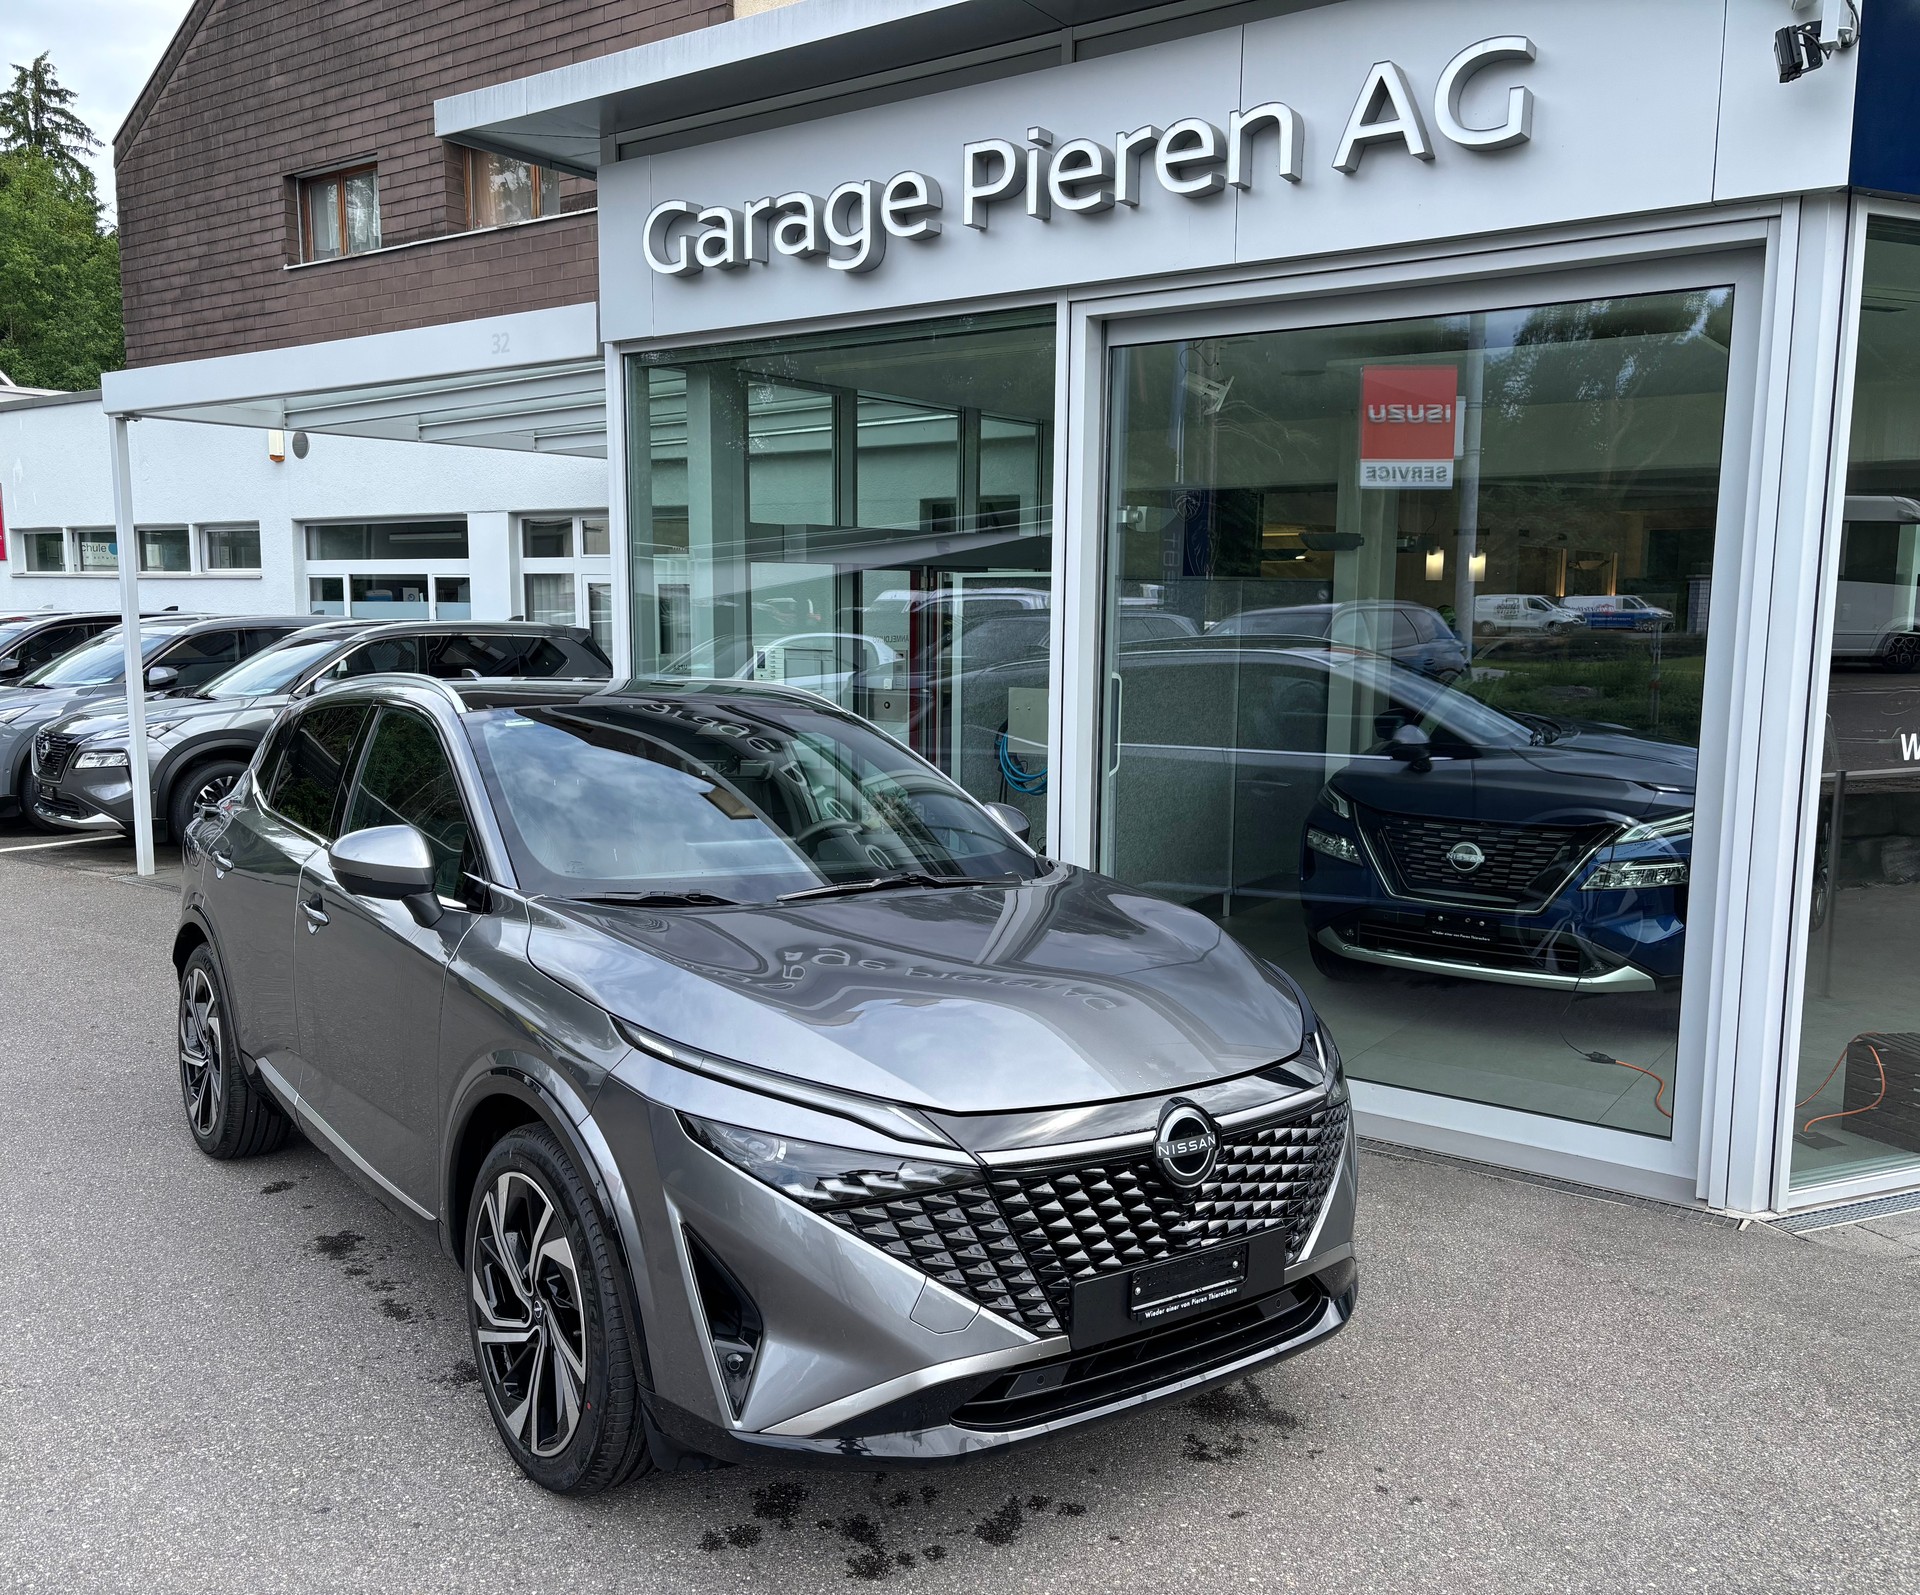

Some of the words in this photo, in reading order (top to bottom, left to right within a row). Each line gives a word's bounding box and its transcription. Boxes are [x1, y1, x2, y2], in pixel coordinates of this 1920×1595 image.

[643, 170, 943, 277] Garage
[963, 101, 1304, 230] Pieren
[1331, 35, 1536, 174] AG
[491, 332, 511, 355] 32
[1158, 1134, 1216, 1156] NISSAN
[1144, 1308, 1165, 1318] Wieder
[1166, 1304, 1180, 1312] einer
[1180, 1301, 1191, 1309] von
[1191, 1296, 1208, 1306] Pieren
[1208, 1287, 1238, 1300] Thierachern
